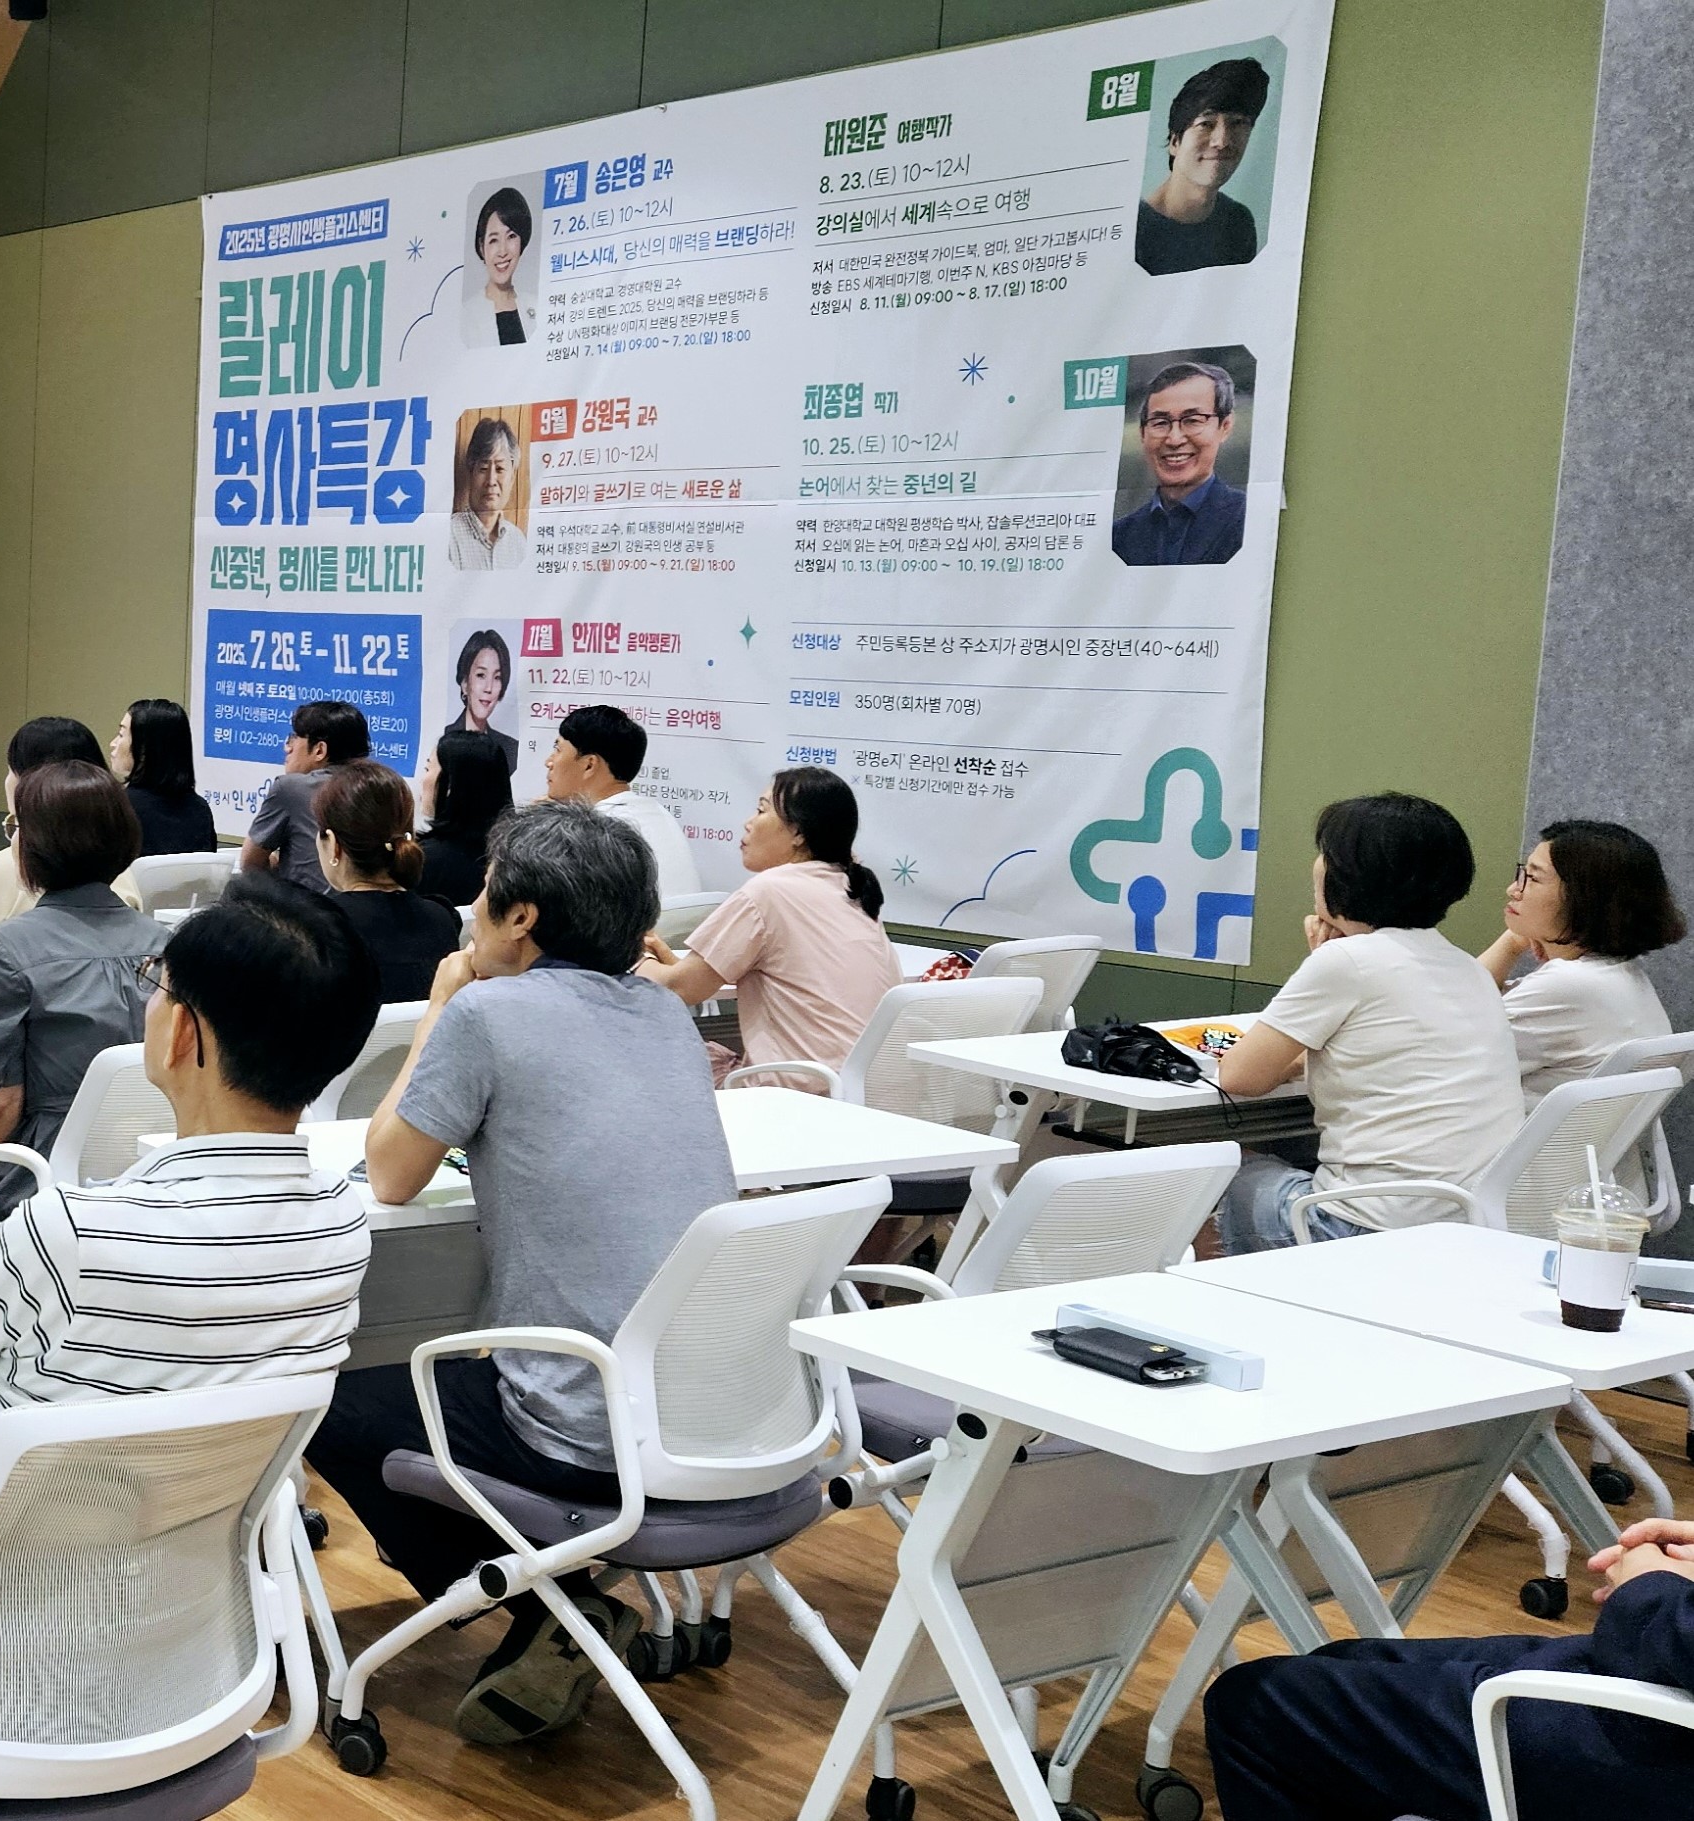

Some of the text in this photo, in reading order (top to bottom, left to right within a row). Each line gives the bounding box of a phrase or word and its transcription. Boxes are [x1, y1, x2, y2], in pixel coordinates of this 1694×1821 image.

[1101, 71, 1140, 110] 8월
[824, 113, 952, 156] 태원준 여행작가
[555, 153, 674, 200] 7월 송은영 교수
[841, 154, 970, 191] 23.(토) 10~12시
[569, 197, 673, 233] 26.(토) 10~12시
[816, 188, 1030, 236] 강의실에서 세계속으로 여행
[225, 206, 383, 255] 2025년 광명시인생플러스센터
[551, 221, 795, 273] 웰니스시대, 당신의 매력을 브랜딩하라!
[220, 260, 386, 398] 릴레이
[803, 365, 1119, 420] 최종엽 작가 10월
[540, 398, 658, 435] 9월 강원국 교수
[213, 396, 432, 526] 명사특강
[558, 443, 658, 467] 27.(토) 10~12시
[830, 431, 958, 455] 25.(토) 10~12시
[541, 478, 741, 505] 말하기와 글쓰기로 여는 새로운 삶
[799, 471, 977, 497] 논어에서 찾는 중년의 길
[211, 545, 424, 599] 신중년, 명사를 만나다!
[217, 630, 357, 674] 2025. 7. 11.
[528, 622, 681, 654] 11월 안지연 음악평론가
[792, 633, 1220, 659] 신청대상 주민등록등본 상 주소지가 광명시인 중장년(40~64세)
[216, 680, 296, 700] 매월 토요일
[528, 669, 650, 688] 11. 22.(토) 10~12시
[666, 708, 722, 731] 음악여행
[789, 690, 981, 716] 모집인원 350명(회차별 70명)
[214, 727, 232, 743] 문의
[786, 746, 837, 765] 신청방법
[909, 755, 950, 773] 온라인
[954, 756, 996, 776] 선착순
[1000, 760, 1029, 778] 접수
